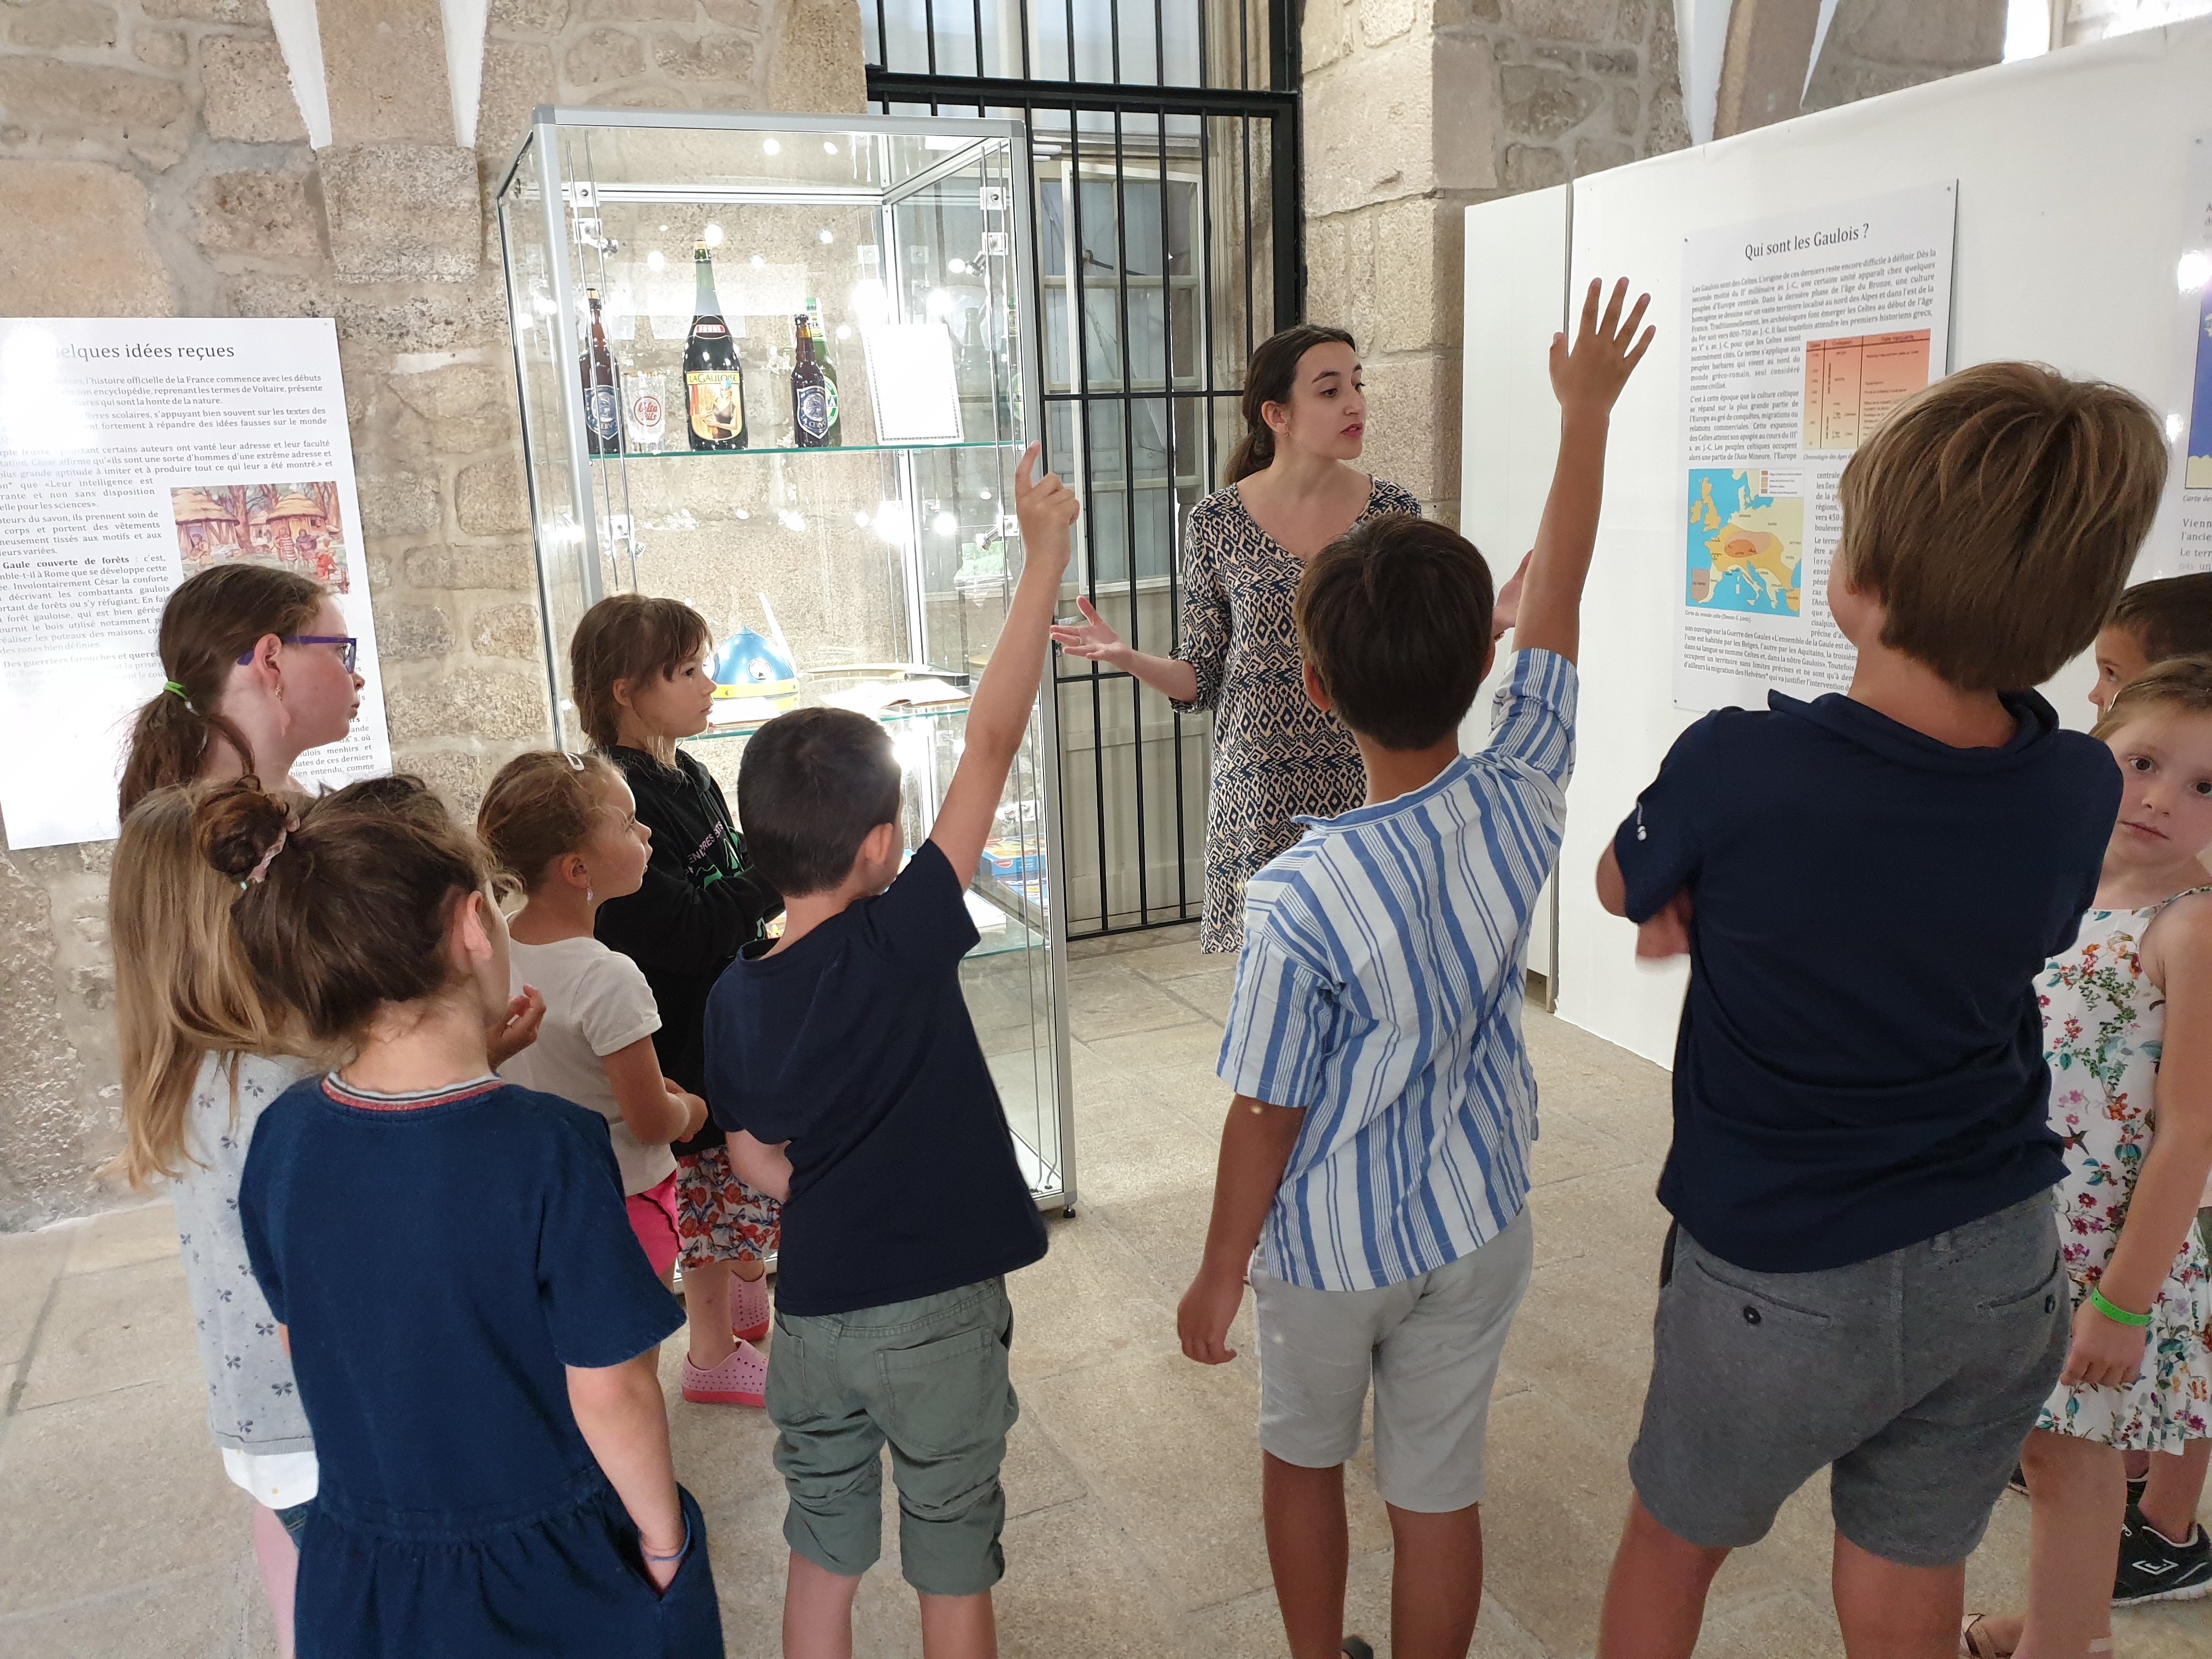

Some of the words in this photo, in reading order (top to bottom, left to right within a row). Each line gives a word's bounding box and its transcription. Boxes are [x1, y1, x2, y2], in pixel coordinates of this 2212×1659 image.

[1745, 242, 1763, 261] Qui
[1766, 239, 1791, 256] sont
[1794, 236, 1810, 250] les
[1813, 226, 1859, 247] Gaulois
[1863, 223, 1869, 238] ?
[57, 343, 120, 362] elques
[125, 343, 172, 357] idées
[178, 347, 234, 361] reçues
[86, 376, 125, 384] l'histoire
[126, 375, 164, 383] officielle
[165, 375, 176, 383] de
[187, 375, 215, 383] France
[281, 374, 293, 382] les
[698, 374, 737, 383] GAULOISE
[93, 386, 154, 397] encyclopédie,
[154, 386, 197, 396] reprenant
[198, 385, 210, 393] les
[210, 385, 240, 393] termes
[241, 385, 252, 393] de
[252, 384, 287, 394] Voltaire,
[287, 383, 323, 394] présente
[826, 396, 836, 407] TA
[111, 410, 153, 421] scolaires,
[153, 409, 201, 420] s'appuyant
[202, 409, 222, 417] bien
[223, 408, 256, 416] souvent
[272, 407, 285, 415] les
[285, 407, 311, 415] textes
[312, 406, 326, 414] des
[101, 421, 145, 430] fortement
[148, 420, 154, 428] à
[156, 420, 195, 431] répandre
[198, 419, 213, 427] des
[216, 419, 238, 427] idées
[240, 417, 270, 426] fausses
[289, 417, 297, 425] le
[299, 416, 327, 425] monde
[102, 444, 137, 453] certains
[140, 443, 173, 452] auteurs
[176, 442, 190, 451] ont
[193, 442, 217, 450] vanté
[219, 441, 236, 449] leur
[239, 440, 270, 449] adresse
[273, 439, 281, 448] et
[284, 439, 300, 448] leur
[303, 438, 330, 447] faculté
[1814, 524, 1843, 532] boulevers
[2182, 518, 2212, 528] Vienn
[2181, 531, 2212, 540] l'ancie
[2194, 549, 2212, 557] terr
[2, 560, 30, 569] Gaule
[36, 558, 78, 567] couverte
[84, 557, 96, 566] de
[101, 556, 129, 565] forêts
[144, 555, 165, 566] c'est,
[37, 570, 42, 578] à
[44, 569, 70, 578] Rome
[71, 569, 88, 578] que
[100, 565, 145, 577] développe
[146, 564, 167, 573] cette
[1811, 619, 1836, 628] cisalpins
[1694, 627, 1713, 635] ouvrage
[1726, 629, 1745, 637] Guerre
[1753, 632, 1771, 640] Gaules
[1818, 640, 1834, 648] Gaule
[1810, 630, 1831, 638] précise
[1684, 633, 1696, 641] l'une
[1705, 636, 1723, 645] habitée
[1741, 641, 1759, 651] Belges,
[1760, 643, 1778, 651] l'autre
[1797, 648, 1826, 659] Aquitains,
[1833, 652, 1857, 661] troisièm
[1684, 642, 1696, 650] dans
[1702, 645, 1718, 655] langue
[1743, 650, 1760, 659] Celtes
[1767, 653, 1780, 662] dans
[1786, 656, 1801, 664] nôtre
[1827, 662, 1854, 671] Toutefois
[1684, 652, 1705, 663] occupent
[1715, 656, 1738, 665] territoire
[1752, 661, 1771, 670] limites
[1772, 664, 1794, 675] précises
[1812, 669, 1825, 678] sont
[1826, 672, 1839, 681] qu'à
[1711, 665, 1735, 676] migration
[1735, 668, 1744, 676] des
[1785, 675, 1806, 686] justifier
[1806, 679, 1844, 690] l'intervention
[326, 746, 359, 755] menhirs
[341, 753, 373, 763] derniers
[311, 766, 345, 775] entendu,
